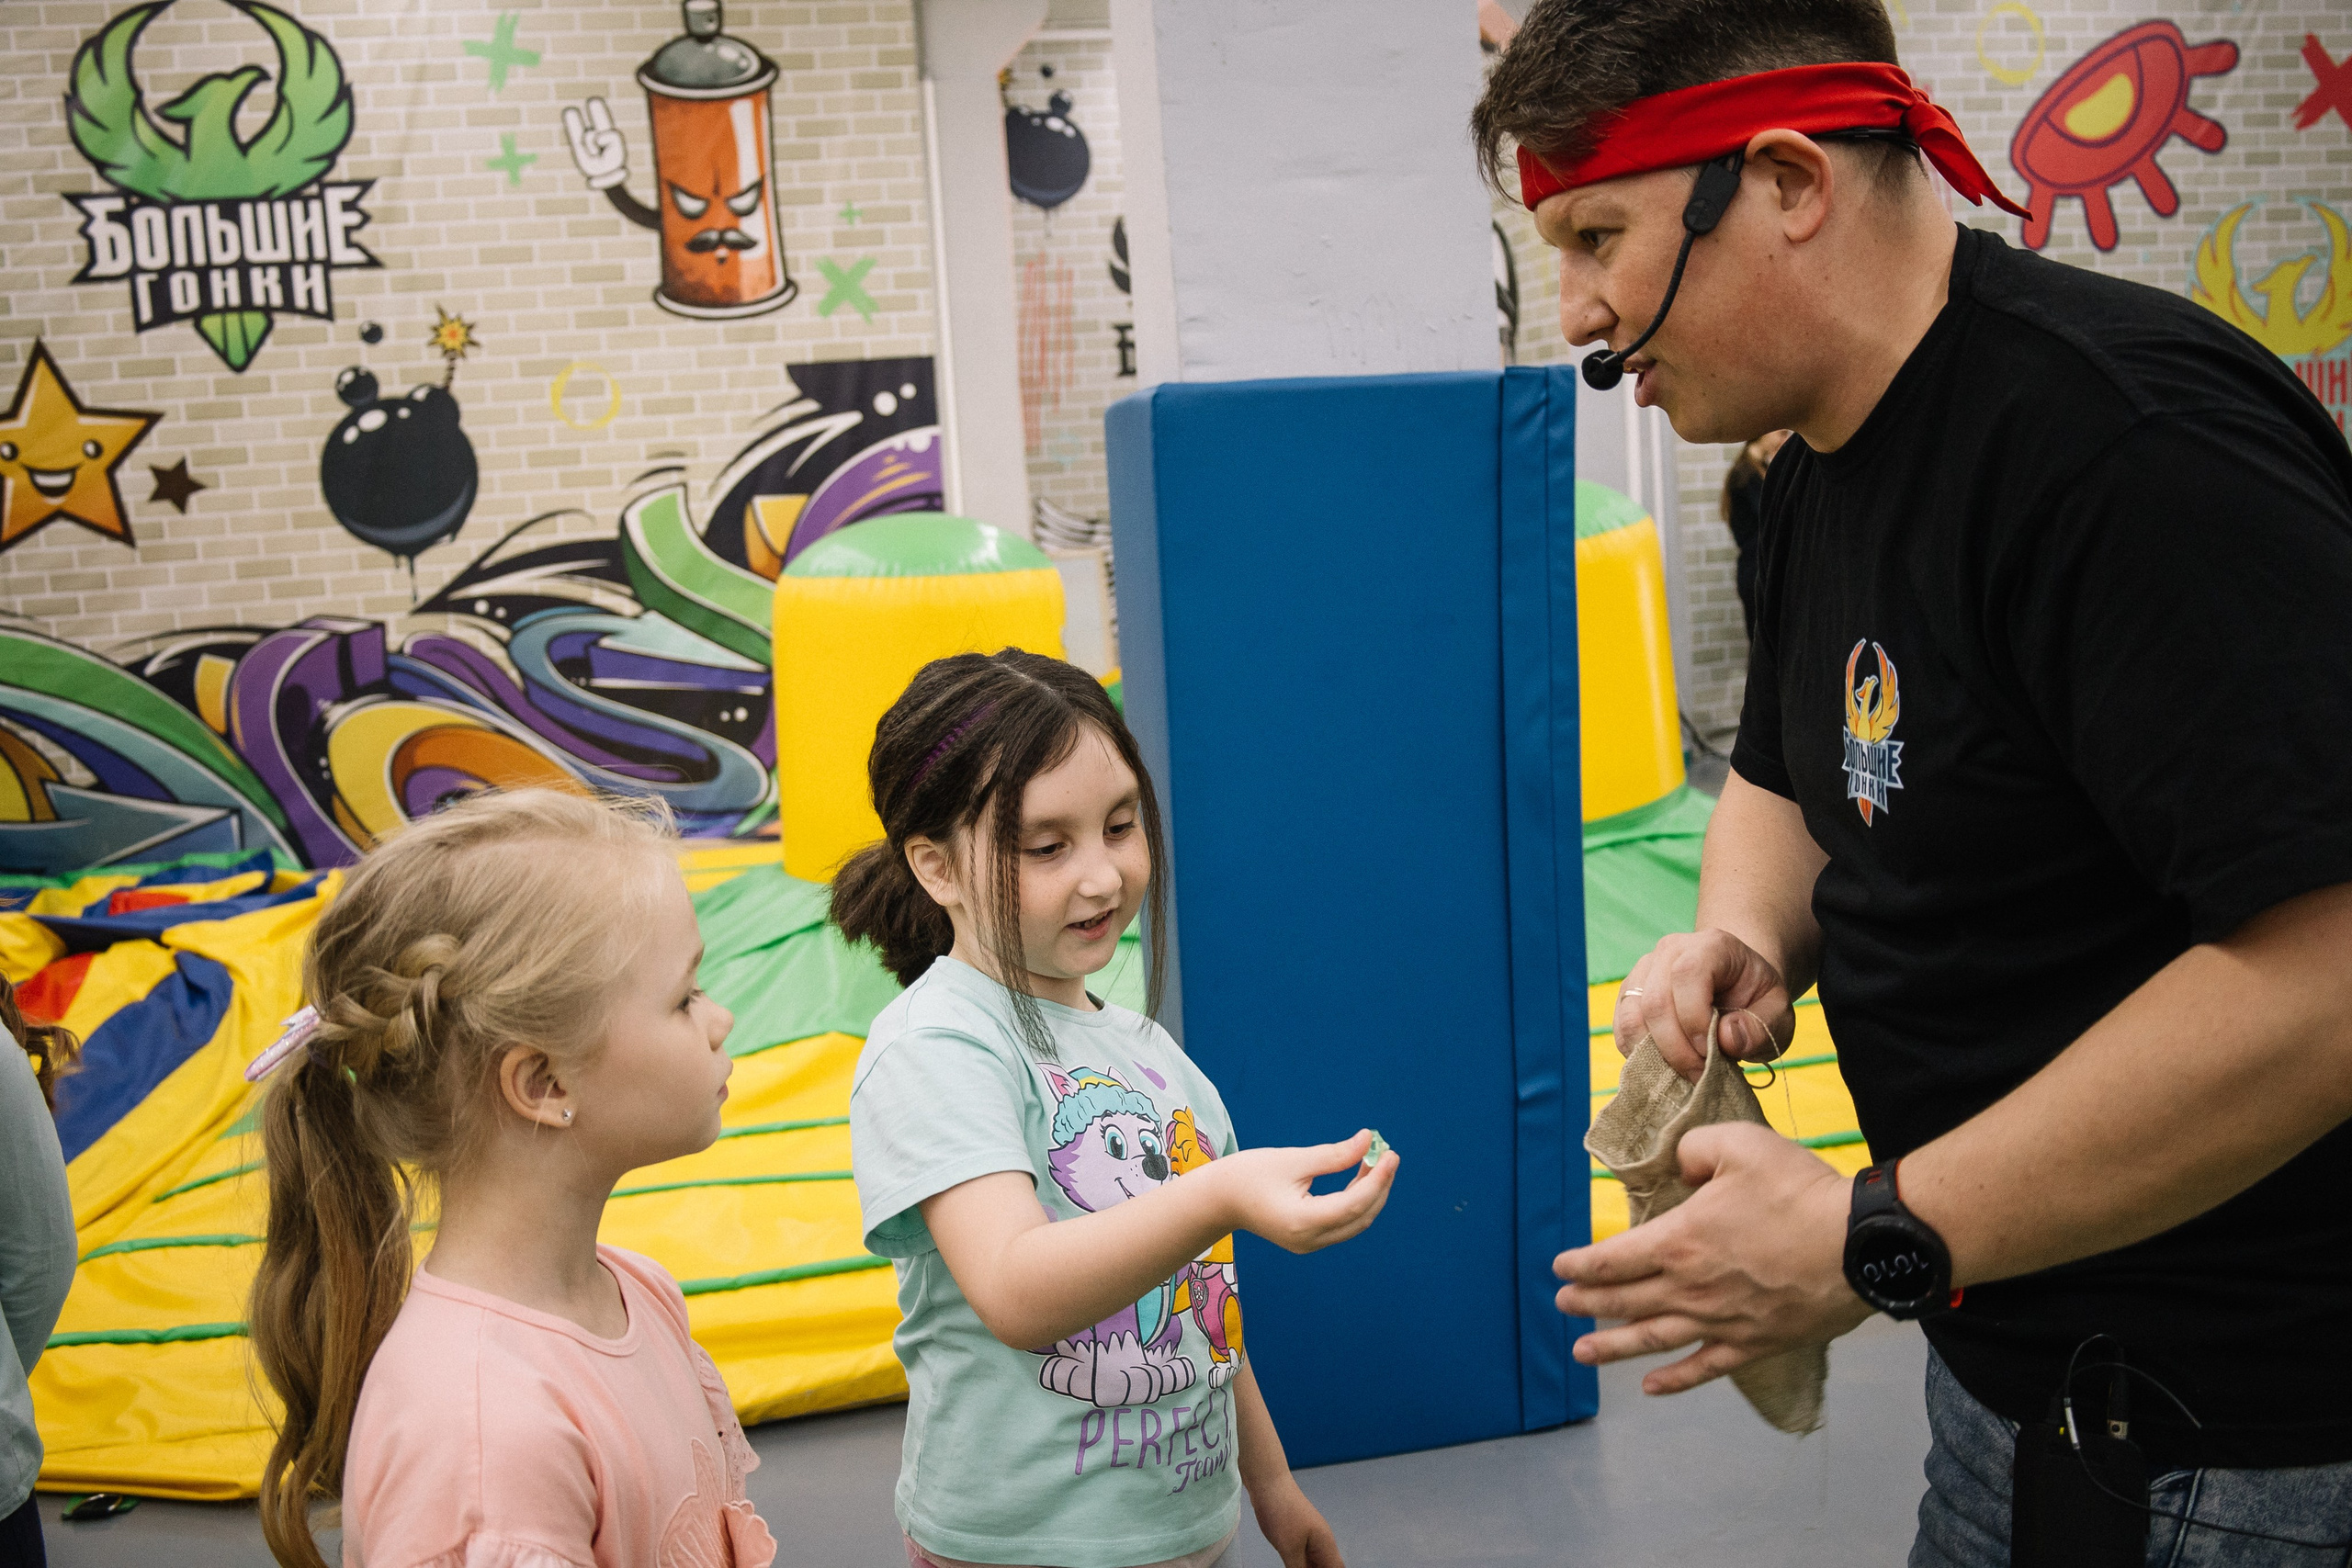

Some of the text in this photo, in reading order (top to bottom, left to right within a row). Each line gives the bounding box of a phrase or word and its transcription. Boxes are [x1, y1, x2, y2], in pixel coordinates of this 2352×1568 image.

[80, 185, 369, 277] БОЛЬШИЕ
[135, 264, 329, 322] ГОНКИ
[1849, 770, 1886, 807] ГОНКИ
